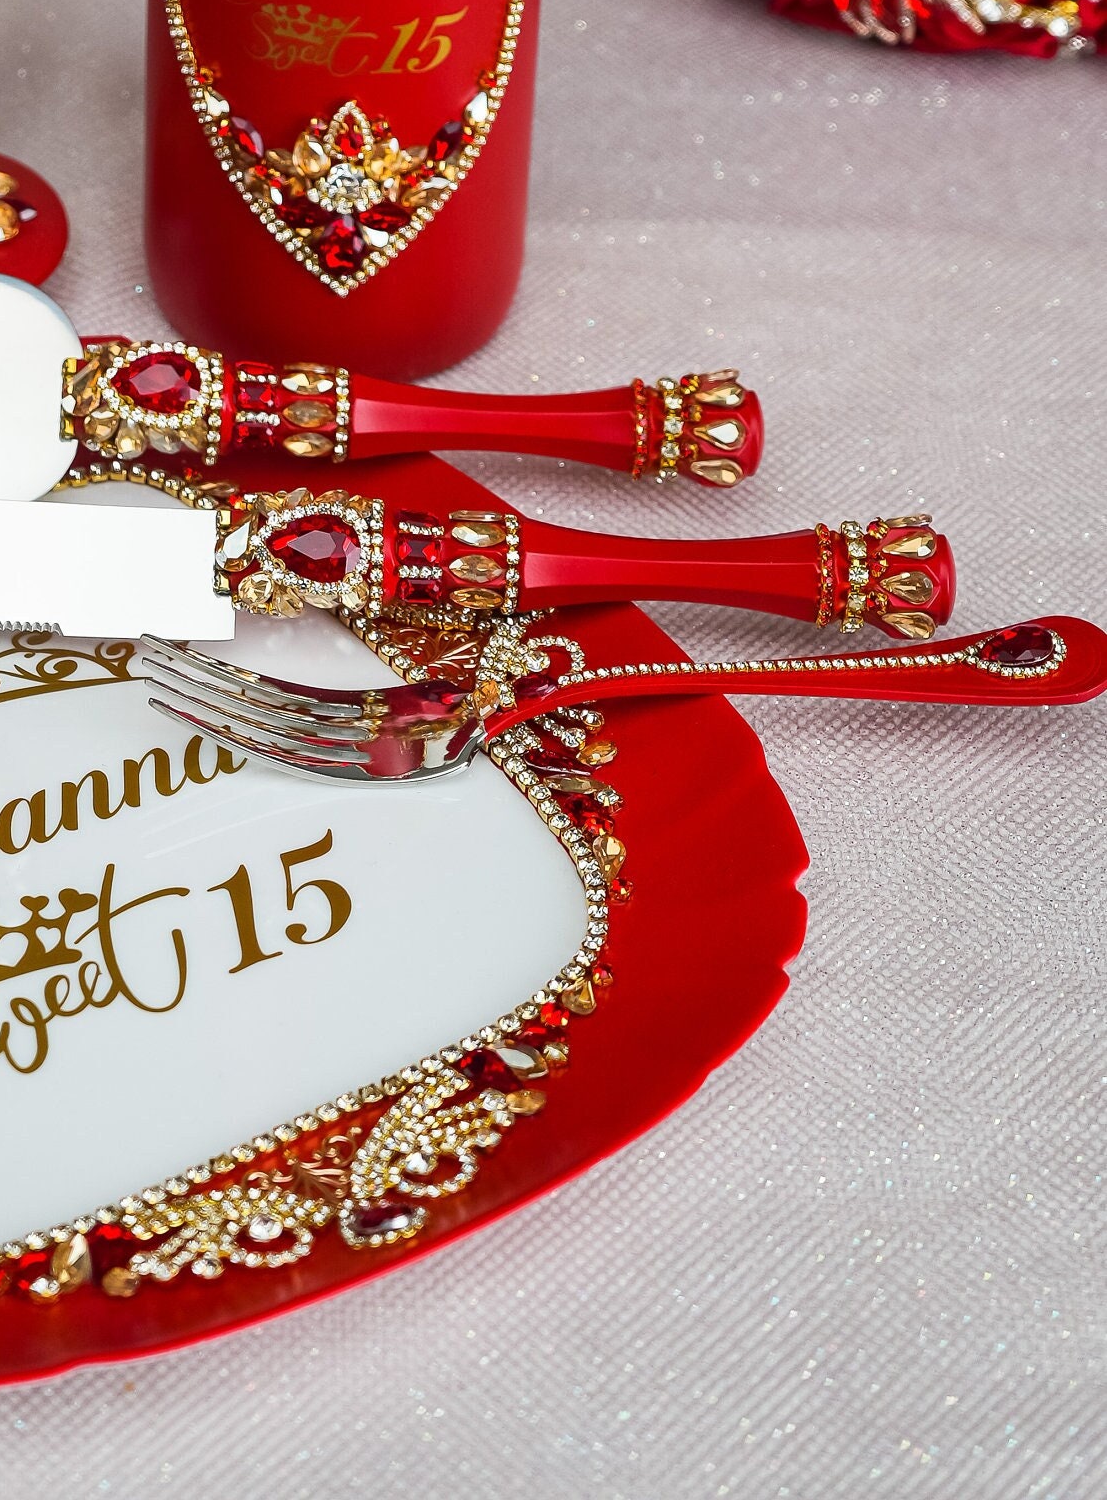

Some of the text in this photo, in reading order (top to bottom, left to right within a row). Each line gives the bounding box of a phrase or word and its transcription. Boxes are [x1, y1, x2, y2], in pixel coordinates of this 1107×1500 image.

[250, 6, 469, 77] Sweet 15
[206, 827, 353, 974] 15
